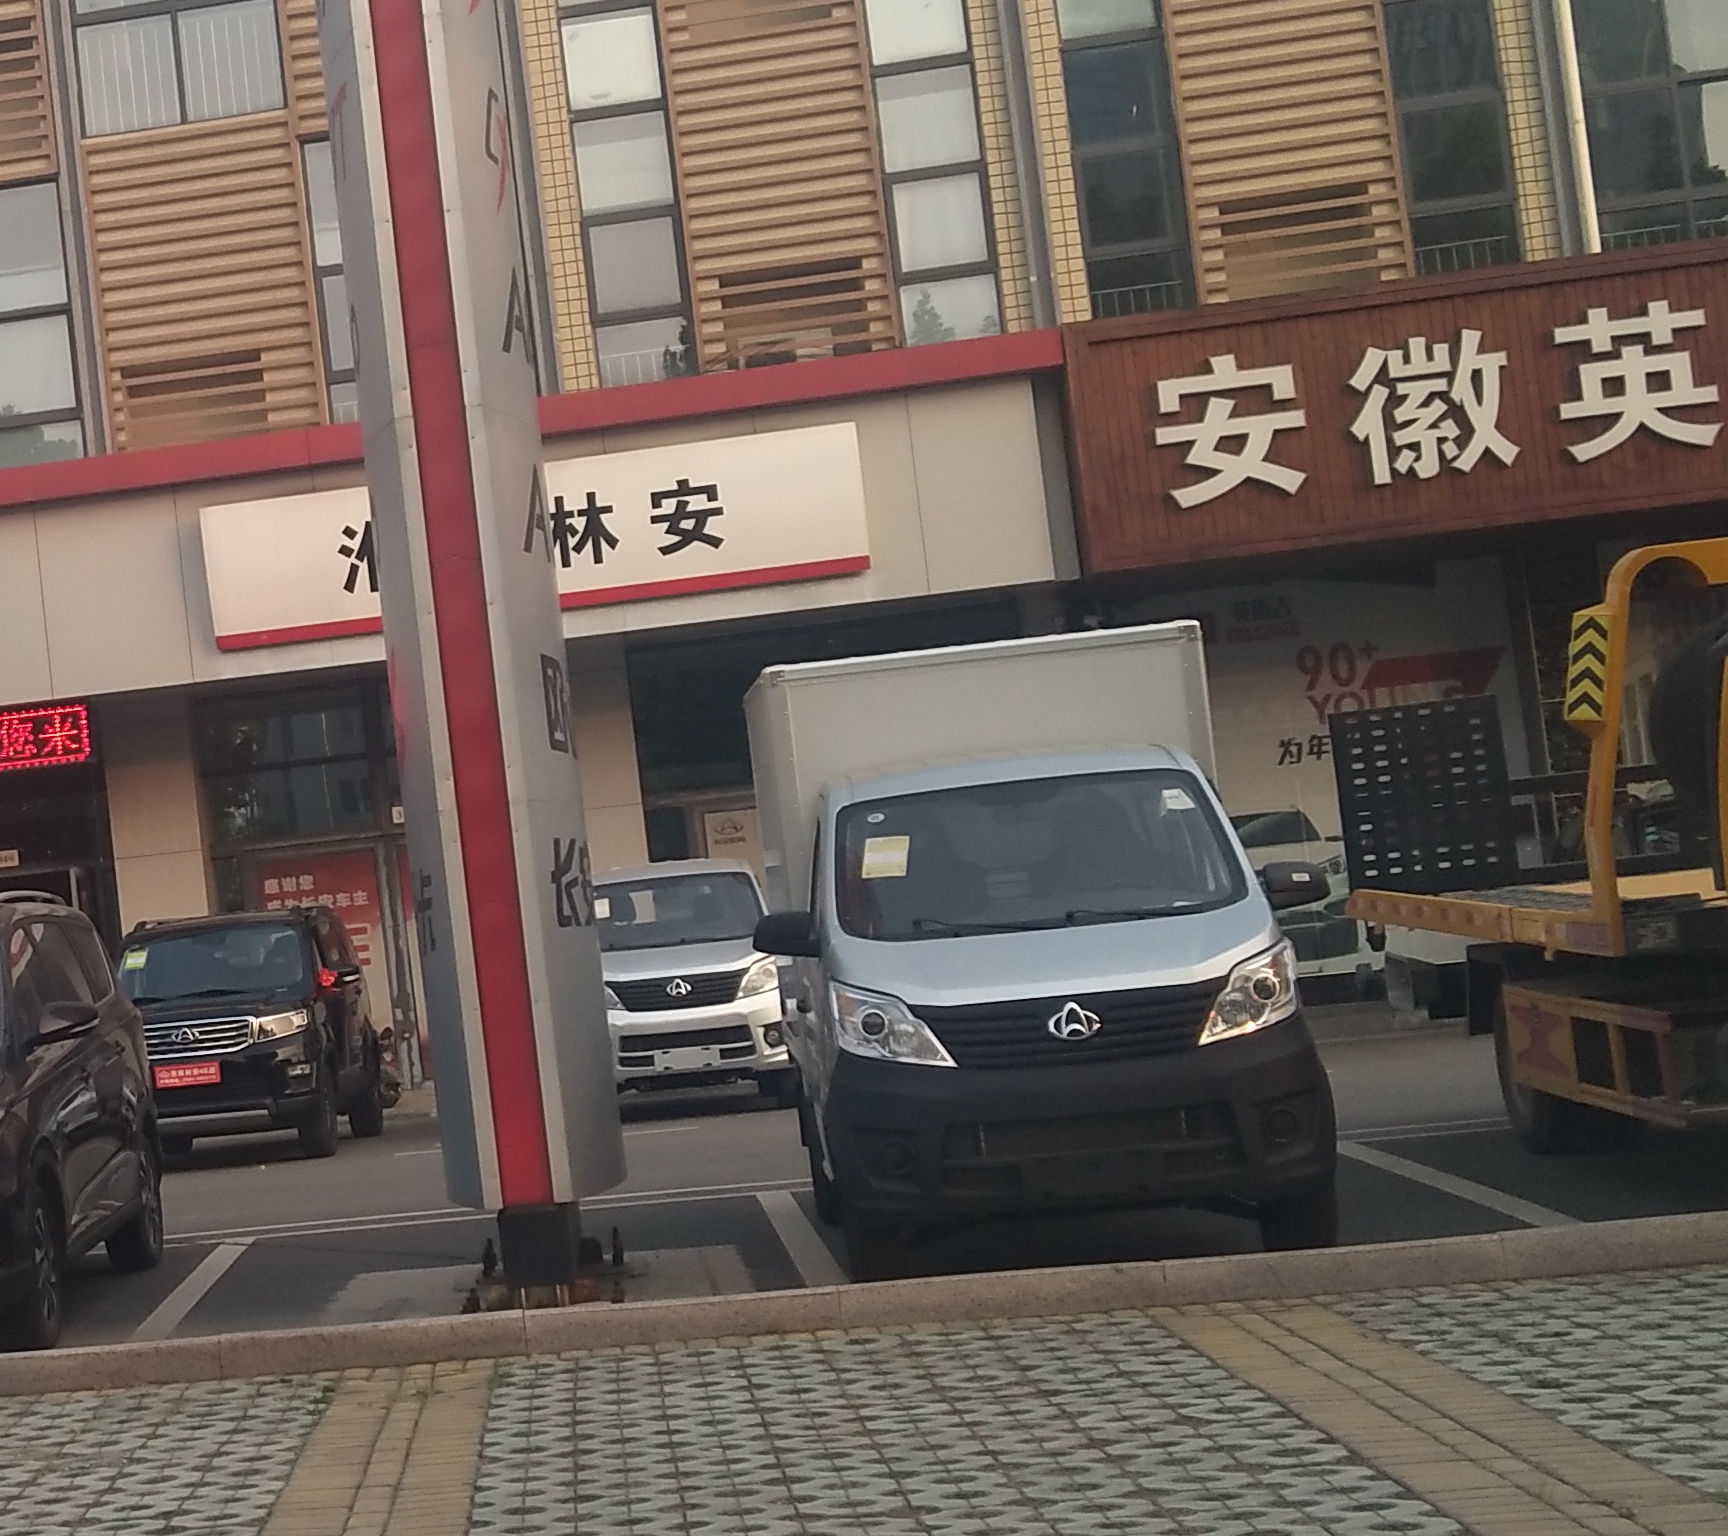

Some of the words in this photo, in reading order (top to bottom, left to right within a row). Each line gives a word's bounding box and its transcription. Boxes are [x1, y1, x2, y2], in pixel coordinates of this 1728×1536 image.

[1155, 300, 1722, 508] 安徽英
[264, 874, 315, 894] 感谢您
